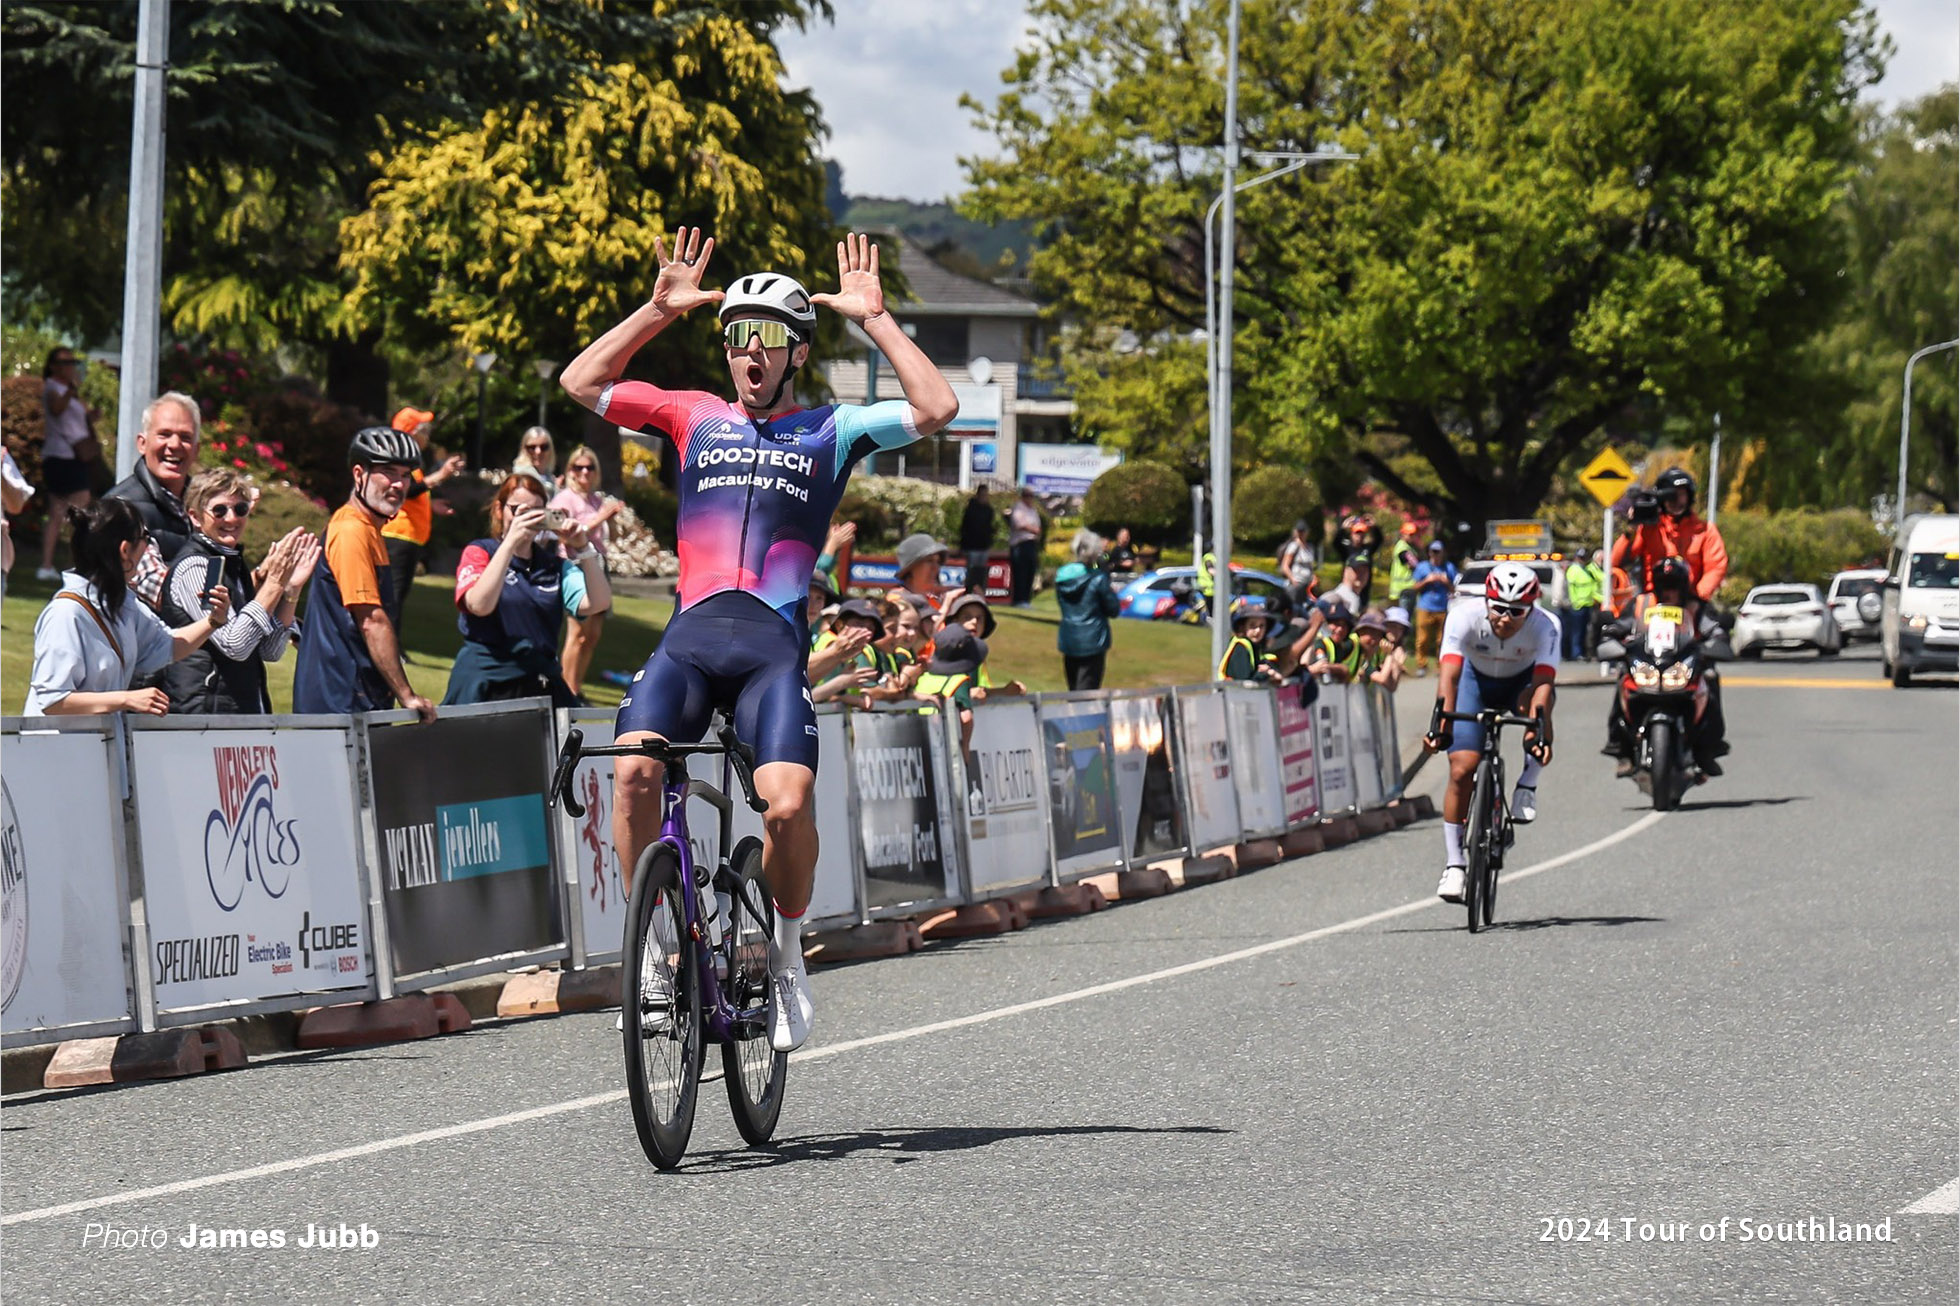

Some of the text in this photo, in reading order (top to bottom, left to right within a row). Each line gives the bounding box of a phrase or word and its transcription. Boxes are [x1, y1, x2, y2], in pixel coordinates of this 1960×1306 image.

[774, 433, 801, 442] UDC
[697, 447, 813, 476] GOODTECH
[697, 473, 809, 503] Macaulay Ford
[856, 746, 927, 801] GOODTECH
[213, 745, 279, 833] WENSLEY'S
[443, 807, 501, 882] jewellers
[913, 820, 937, 863] Ford
[248, 941, 291, 963] Electric Bike
[312, 924, 358, 952] CUBE
[156, 934, 239, 985] SPECIALIZED
[338, 955, 359, 973] BOSCH
